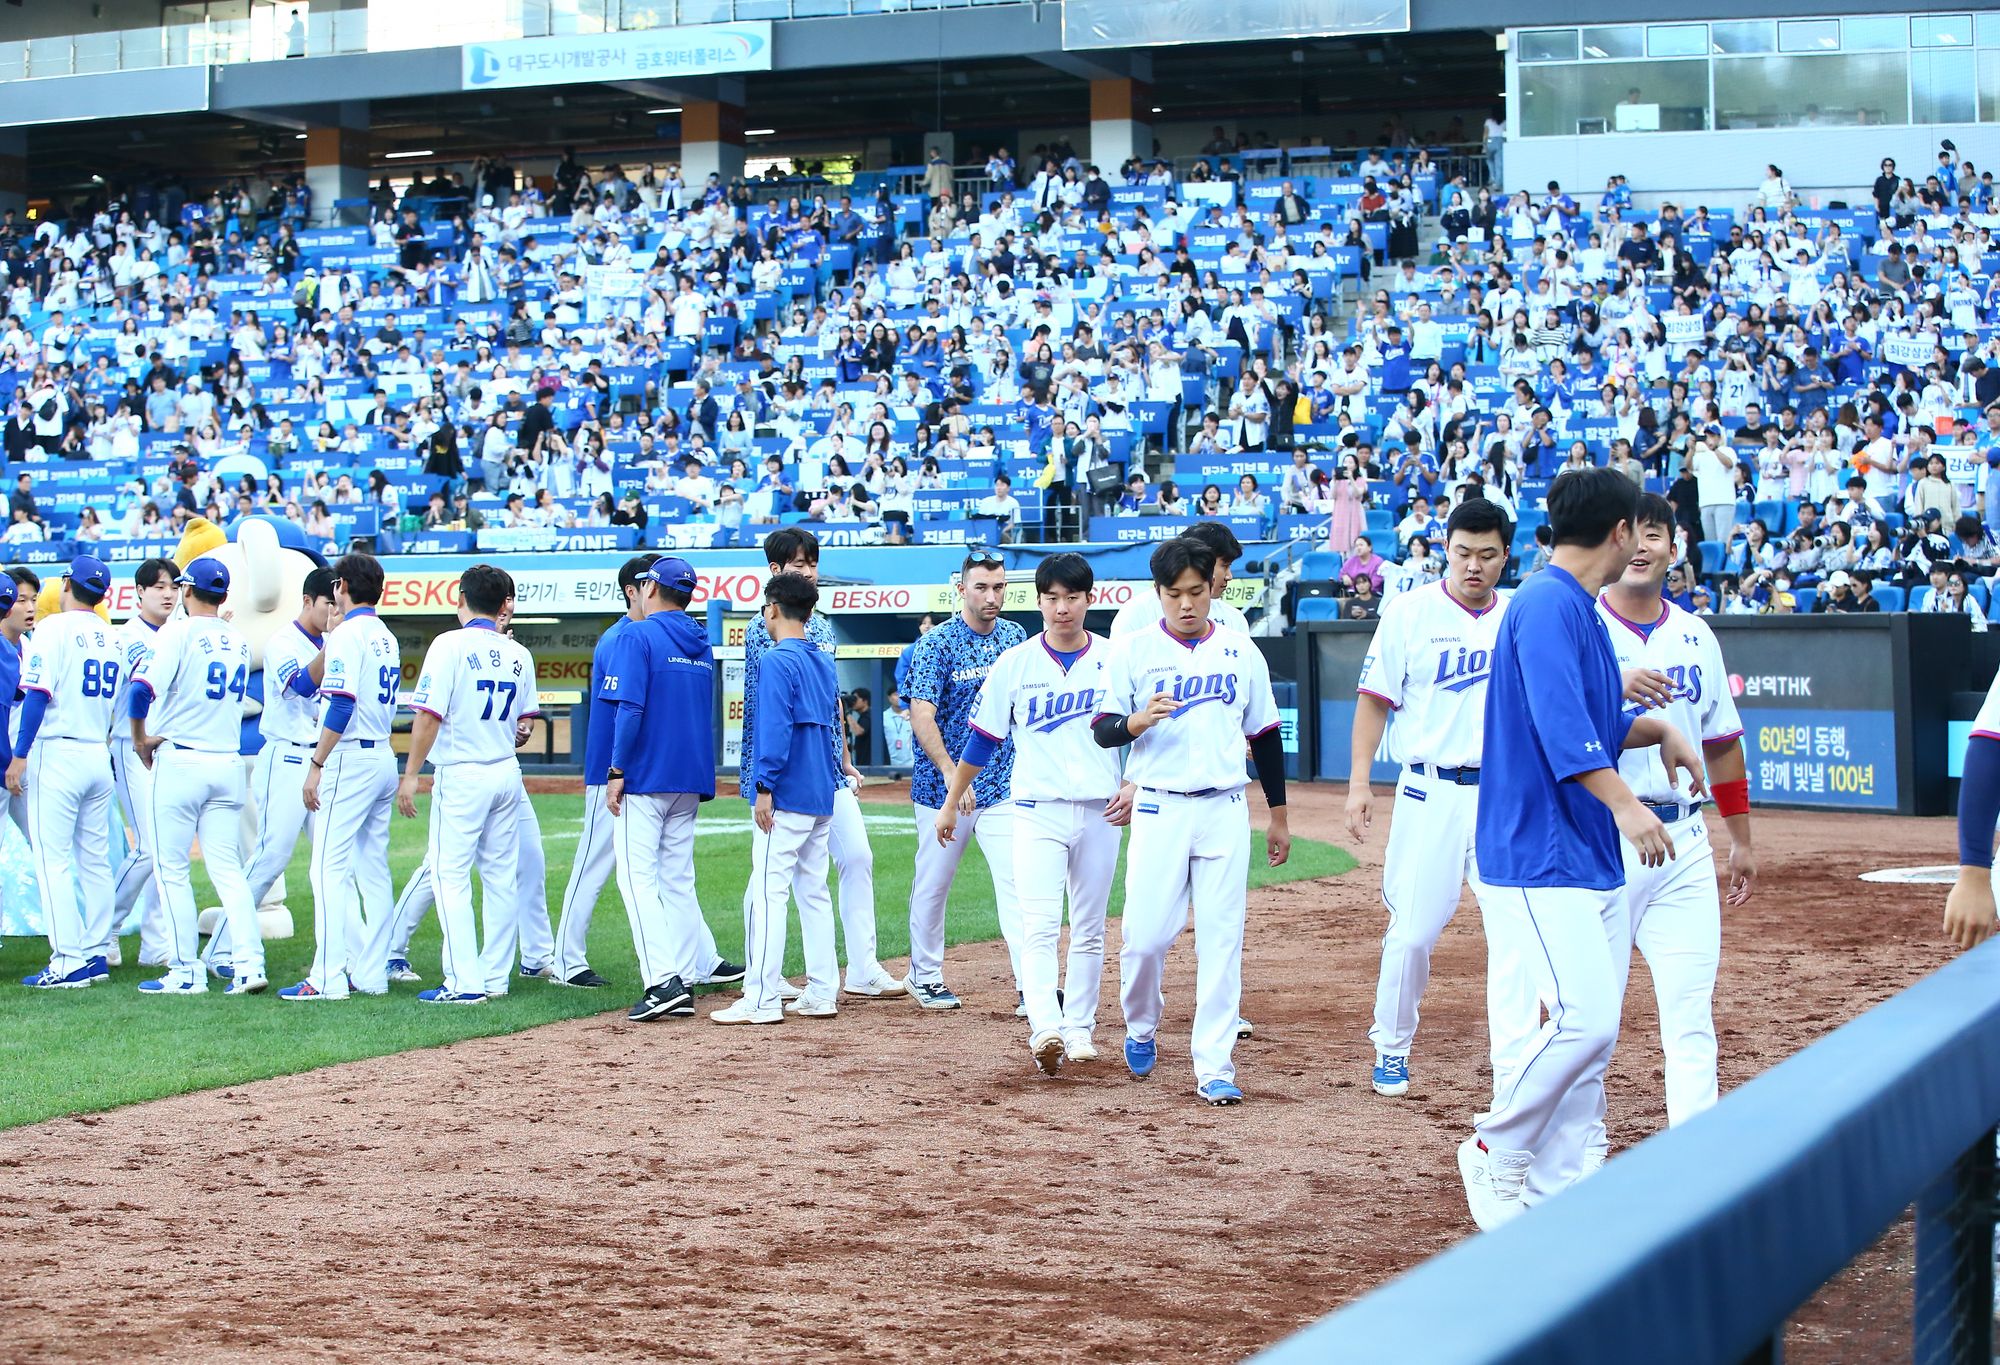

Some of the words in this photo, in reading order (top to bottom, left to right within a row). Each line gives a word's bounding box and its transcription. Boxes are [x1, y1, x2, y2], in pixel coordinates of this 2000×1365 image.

[508, 48, 626, 72] 대구도시개발공사
[635, 47, 736, 70] 금호워터폴리스
[1889, 342, 1935, 360] 최강삼성
[1730, 384, 1744, 398] 21
[1231, 462, 1269, 475] 지브로
[1396, 577, 1414, 593] 47
[832, 589, 910, 610] BESKO
[1430, 636, 1461, 644] SAMSUNG
[668, 656, 692, 666] UNDER
[1147, 665, 1177, 674] SAMSUNG
[1433, 647, 1495, 685] Lio
[82, 658, 120, 699] 89
[206, 661, 246, 702] 94
[603, 675, 619, 691] 76
[951, 666, 992, 682] SAMSU
[378, 665, 400, 705] 97
[1022, 682, 1050, 690] SAMSUNG
[1154, 673, 1237, 705] Lions
[1745, 675, 1811, 697] 삼익THK
[476, 679, 517, 721] 77
[1026, 688, 1094, 727] Lion
[1759, 725, 1810, 756] 60년의
[1814, 726, 1850, 761] 동행,
[1759, 760, 1790, 791] 함께
[1793, 763, 1824, 793] 빛낼
[1827, 764, 1874, 795] 100년
